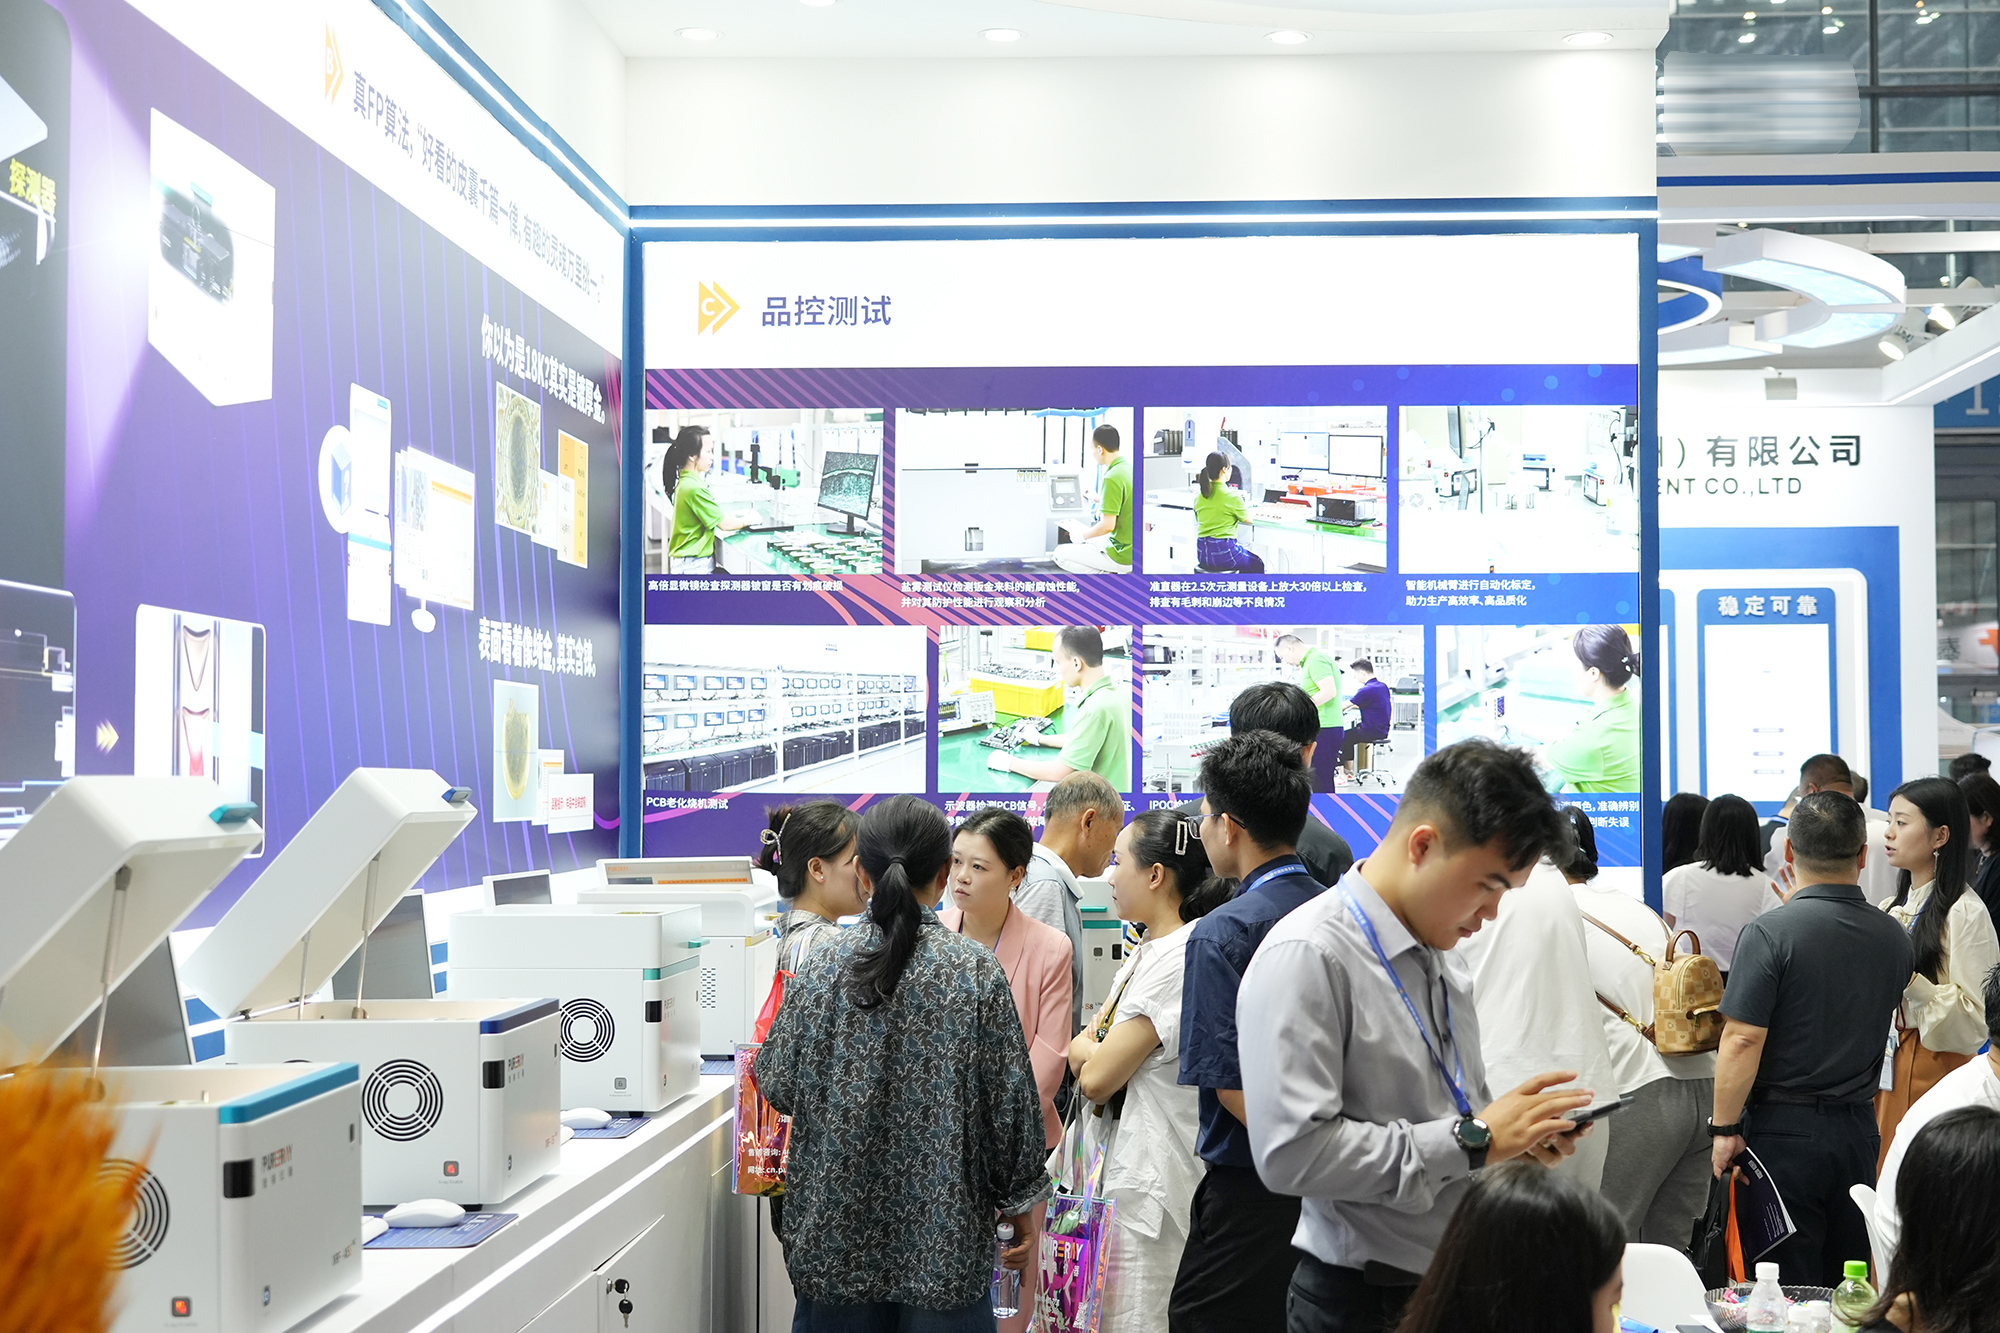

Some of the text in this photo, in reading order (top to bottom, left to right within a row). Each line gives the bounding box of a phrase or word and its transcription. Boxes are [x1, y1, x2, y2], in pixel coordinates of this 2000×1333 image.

[701, 297, 716, 316] C
[762, 295, 892, 327] 品控测试
[1705, 477, 1802, 497] CO.,LTD
[1405, 579, 1536, 591] 智能机械臂进行自动化标定，
[901, 597, 1046, 608] 并对其防护性能进行观察和分析
[1149, 597, 1286, 608] 排查有毛刺和崩边等不良情况
[1405, 595, 1527, 606] 助力生产高效率、高品质化
[1718, 595, 1818, 617] 稳定可靠
[646, 797, 729, 810] PCB老化烧机测试
